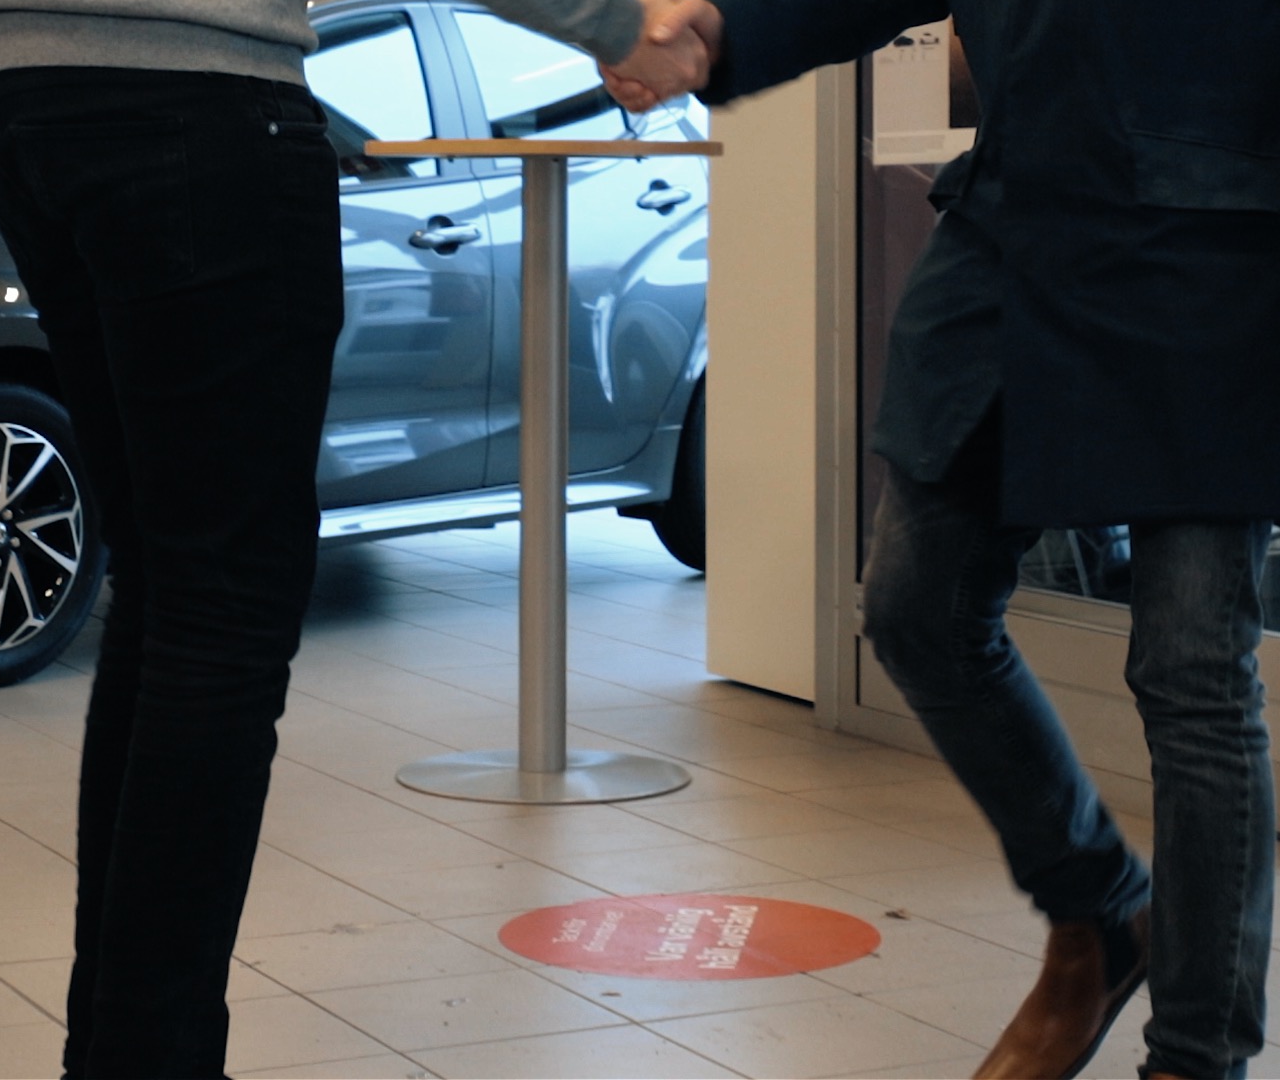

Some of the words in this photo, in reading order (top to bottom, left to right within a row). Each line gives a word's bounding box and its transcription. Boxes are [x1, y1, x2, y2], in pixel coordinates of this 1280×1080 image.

[657, 908, 715, 941] vänlig
[710, 904, 759, 947] avstånd
[644, 941, 688, 962] Var
[695, 947, 742, 970] håll
